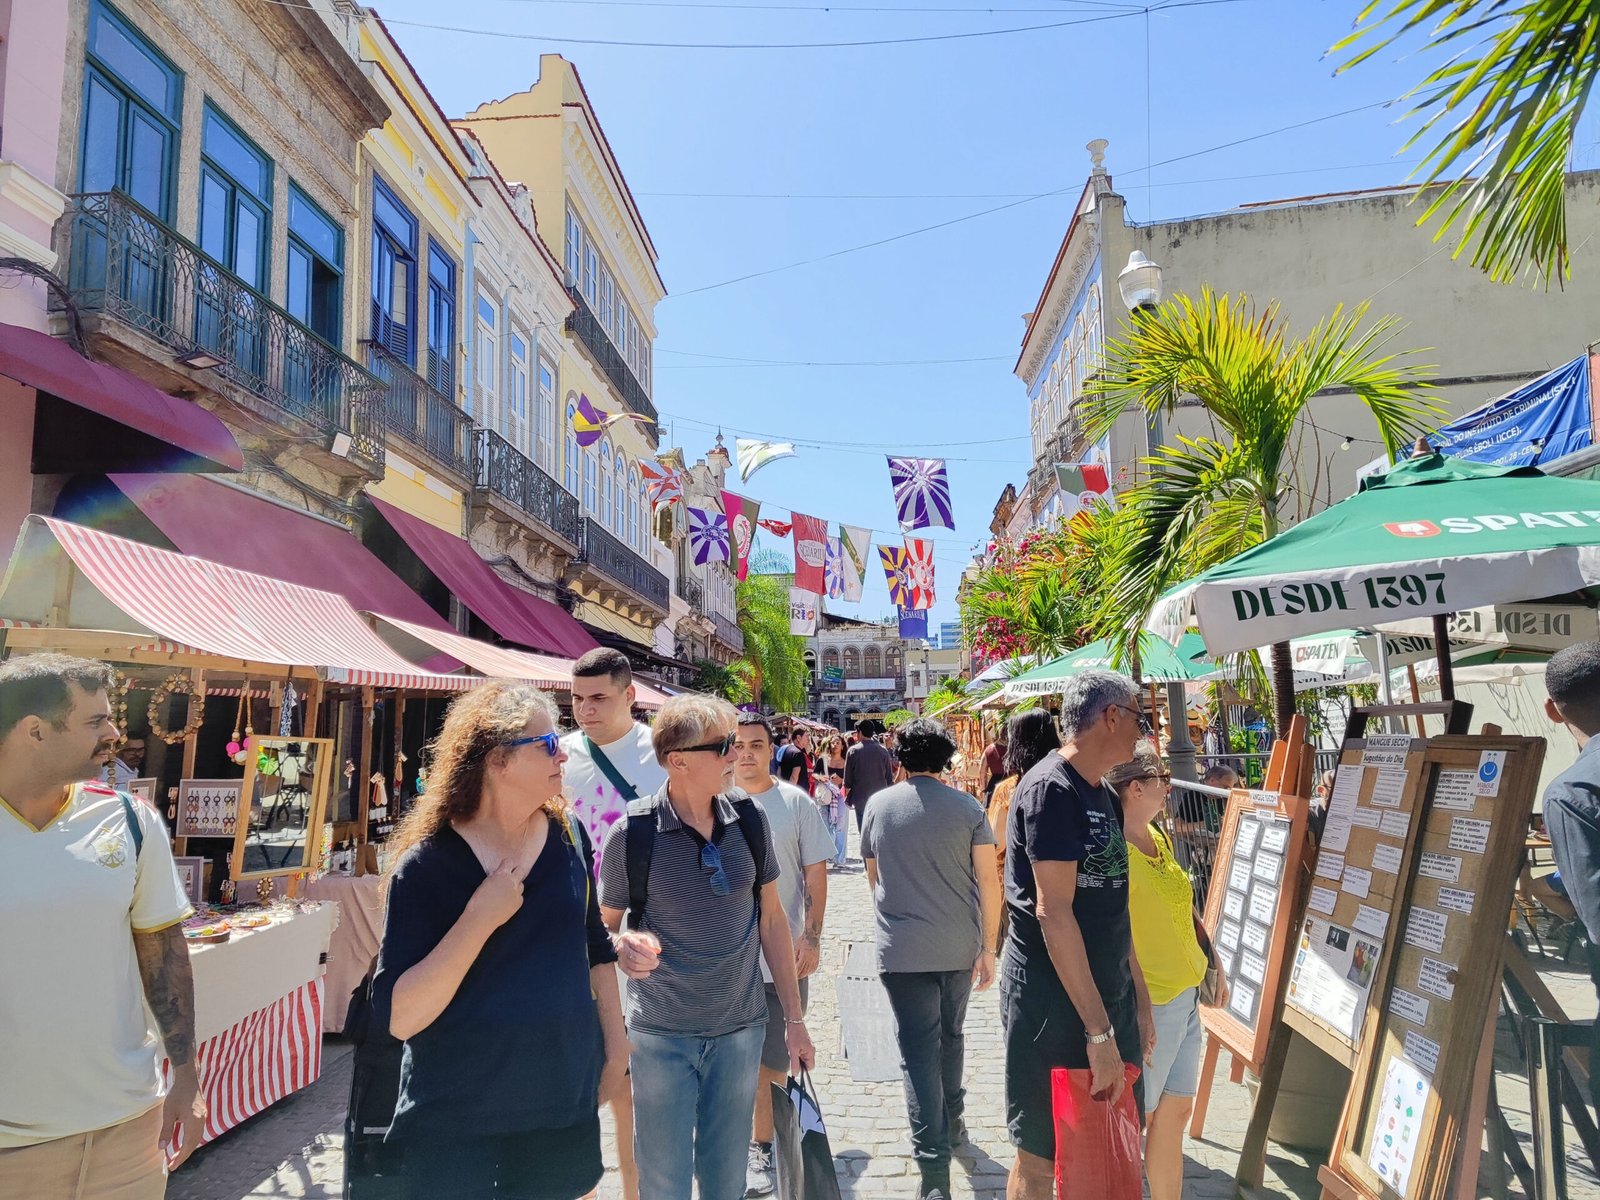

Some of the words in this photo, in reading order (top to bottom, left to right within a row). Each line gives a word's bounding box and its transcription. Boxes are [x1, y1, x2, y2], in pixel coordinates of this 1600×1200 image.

[1453, 433, 1464, 444] DO
[1464, 415, 1502, 440] INSTITUTO
[1503, 410, 1514, 423] DE
[1232, 580, 1356, 621] DESDE
[1361, 572, 1447, 609] 1397
